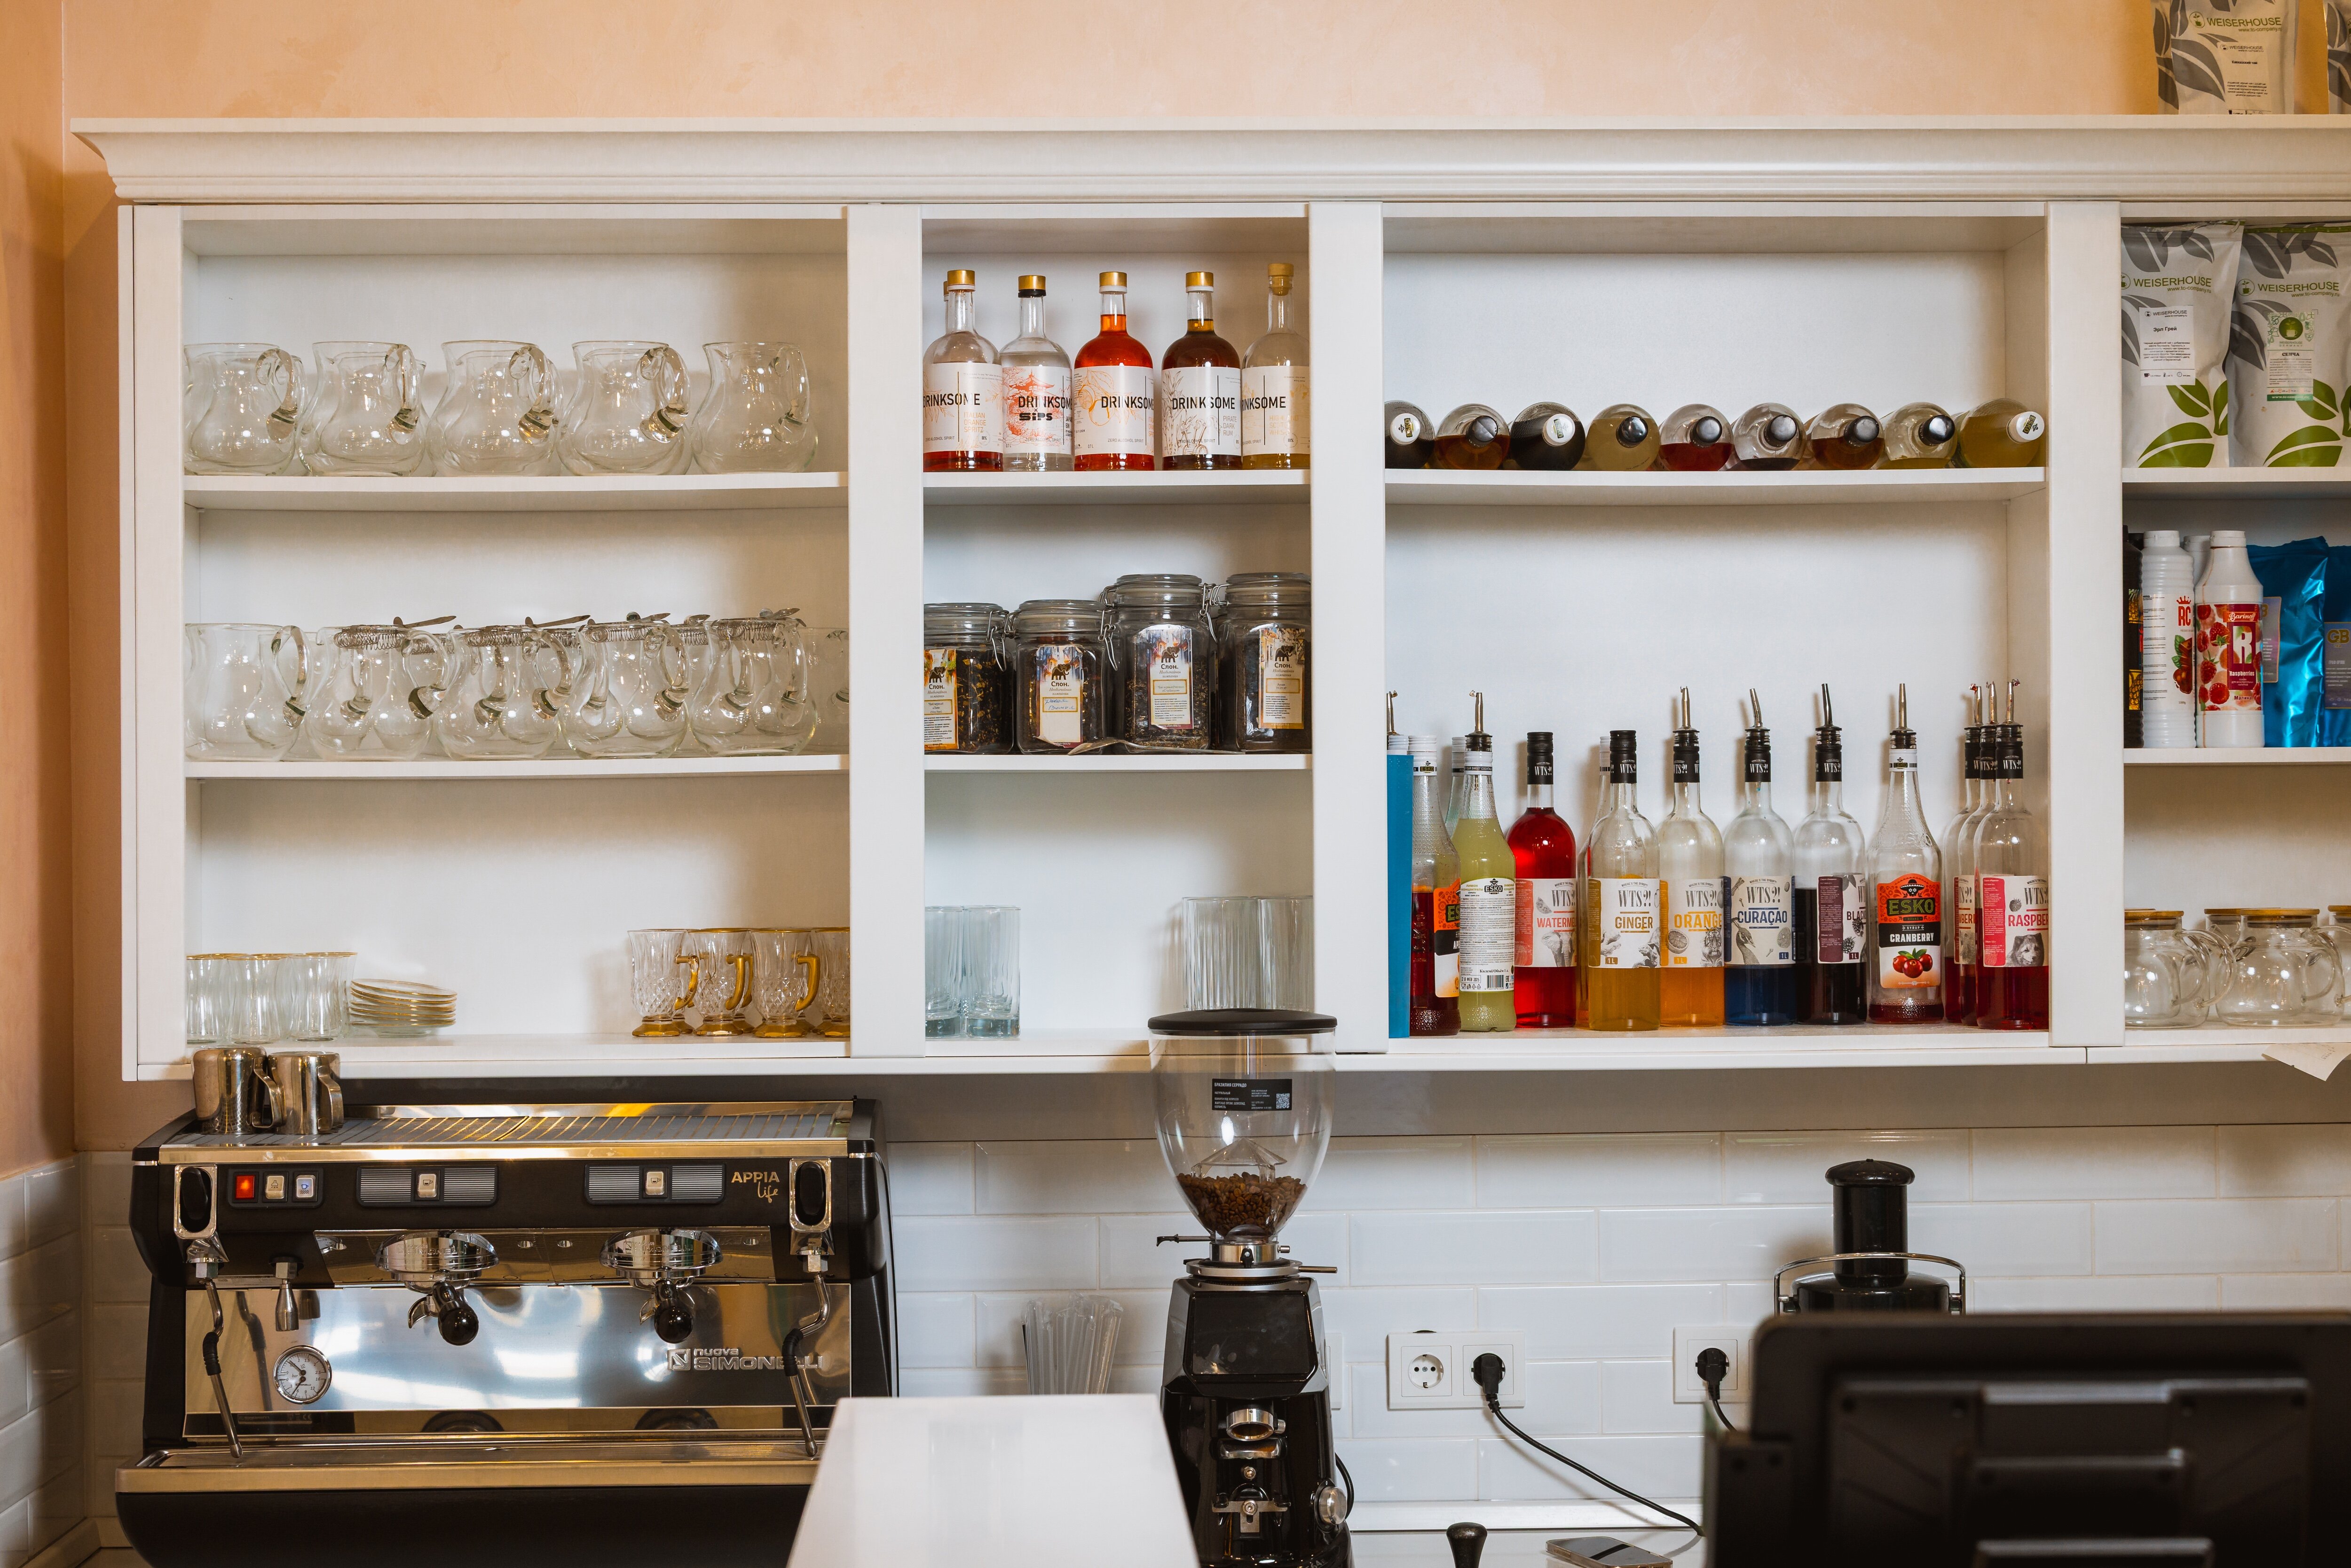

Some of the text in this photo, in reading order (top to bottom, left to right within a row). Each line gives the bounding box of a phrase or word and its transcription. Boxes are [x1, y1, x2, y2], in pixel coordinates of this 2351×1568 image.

[2207, 17, 2282, 27] WEISERHOUSE
[2134, 276, 2212, 287] WEISERHOUSE
[2258, 282, 2339, 292] WEISERHOUSE
[2167, 285, 2211, 293] www.tc-company.ru
[923, 393, 980, 408] DRINKSOME
[1102, 396, 1154, 410] DRINKSOME
[1173, 397, 1235, 410] DRINKSOME
[1242, 396, 1286, 411] RINKSOME
[2178, 606, 2191, 626] RC
[2228, 612, 2256, 621] Barinoff
[2327, 629, 2350, 644] GB
[2233, 626, 2252, 664] R
[1535, 766, 1552, 776] WTS?!
[1750, 764, 1768, 773] WTS?!
[2003, 760, 2021, 770] WTS?!
[1618, 890, 1651, 907] WTS?!
[1685, 890, 1717, 907] WTS?!
[1746, 886, 1780, 903] WTS?!
[1448, 905, 1460, 921] ES
[1889, 899, 1934, 915] ESKO
[1615, 916, 1653, 929] GINGER
[1674, 914, 1722, 928] ORANGE
[1737, 911, 1787, 925] CURAÇAO
[2008, 914, 2048, 927] RASPBER
[1890, 933, 1934, 943] CRANBERRY
[731, 1172, 780, 1183] APPIA
[758, 1181, 778, 1203] life
[694, 1348, 739, 1356] nuova
